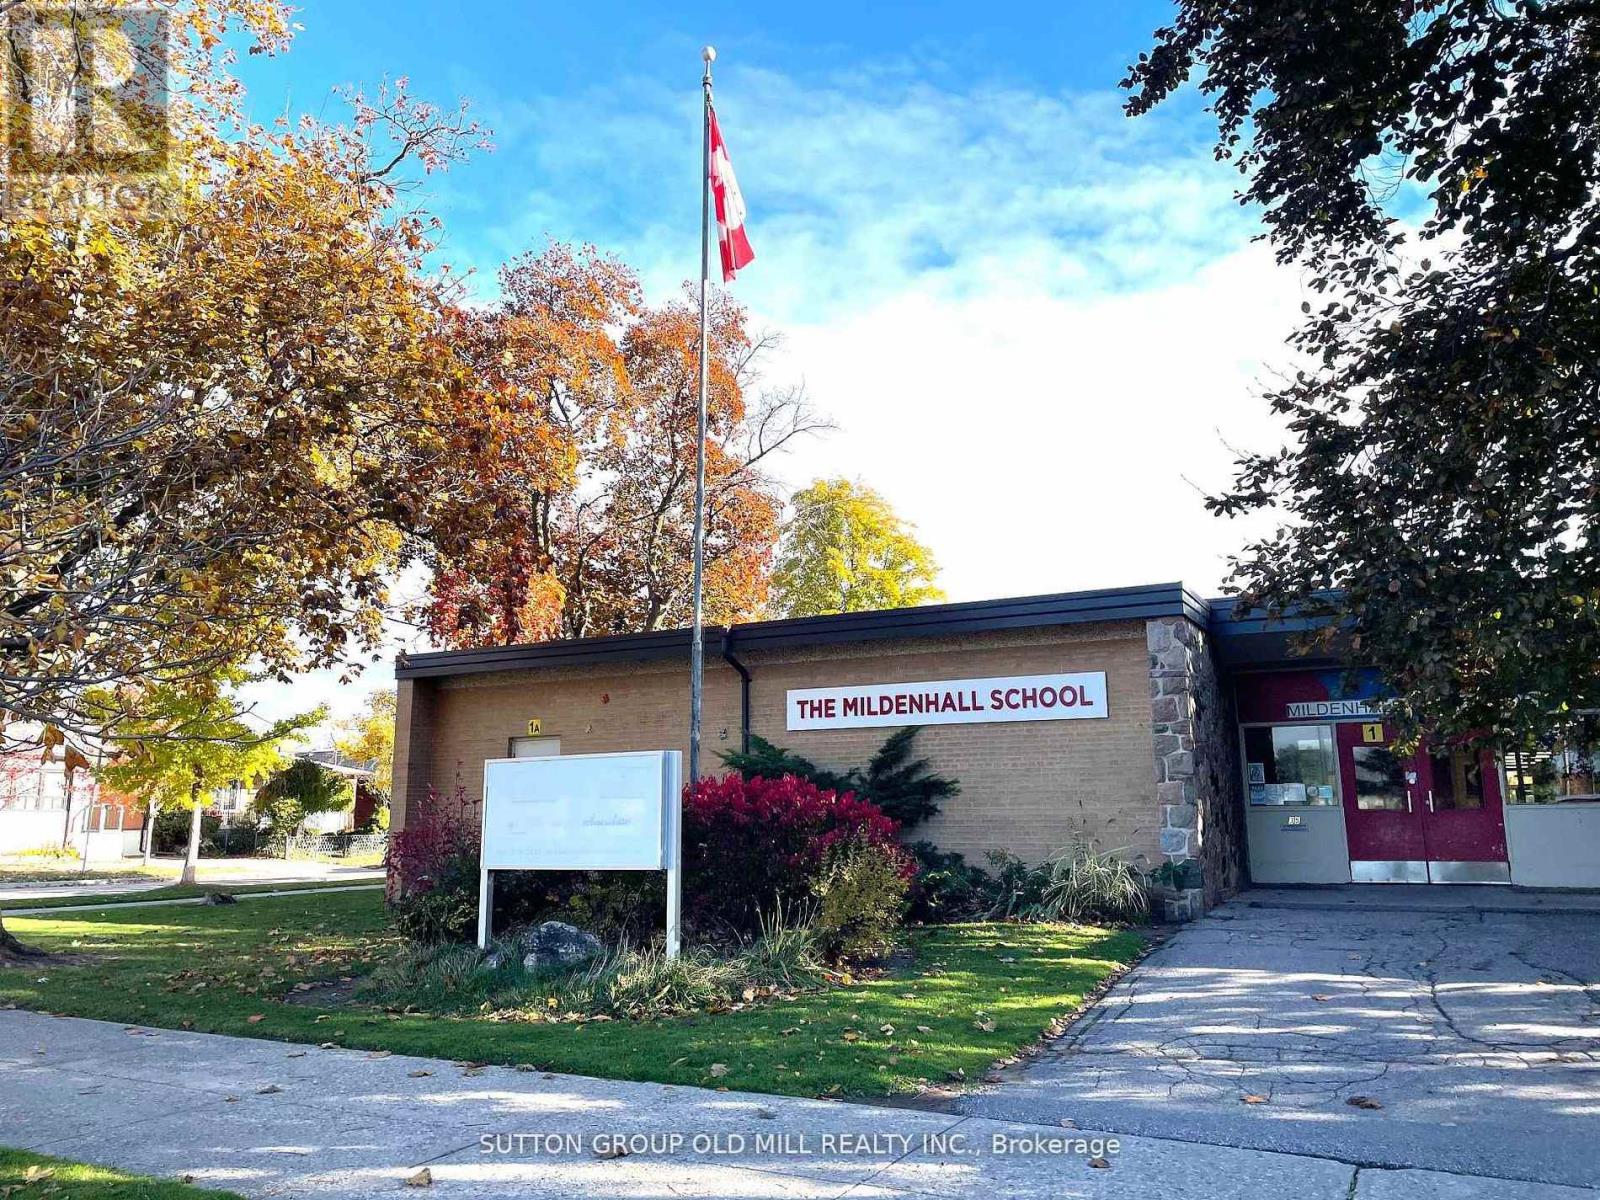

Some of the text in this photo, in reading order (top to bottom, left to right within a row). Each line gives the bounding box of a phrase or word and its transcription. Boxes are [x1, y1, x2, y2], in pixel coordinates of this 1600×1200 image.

[797, 685, 1093, 719] THE MILDENHALL SCHOOL
[1287, 701, 1396, 717] MILDENHA
[529, 720, 540, 733] 1A
[1368, 726, 1376, 740] 1
